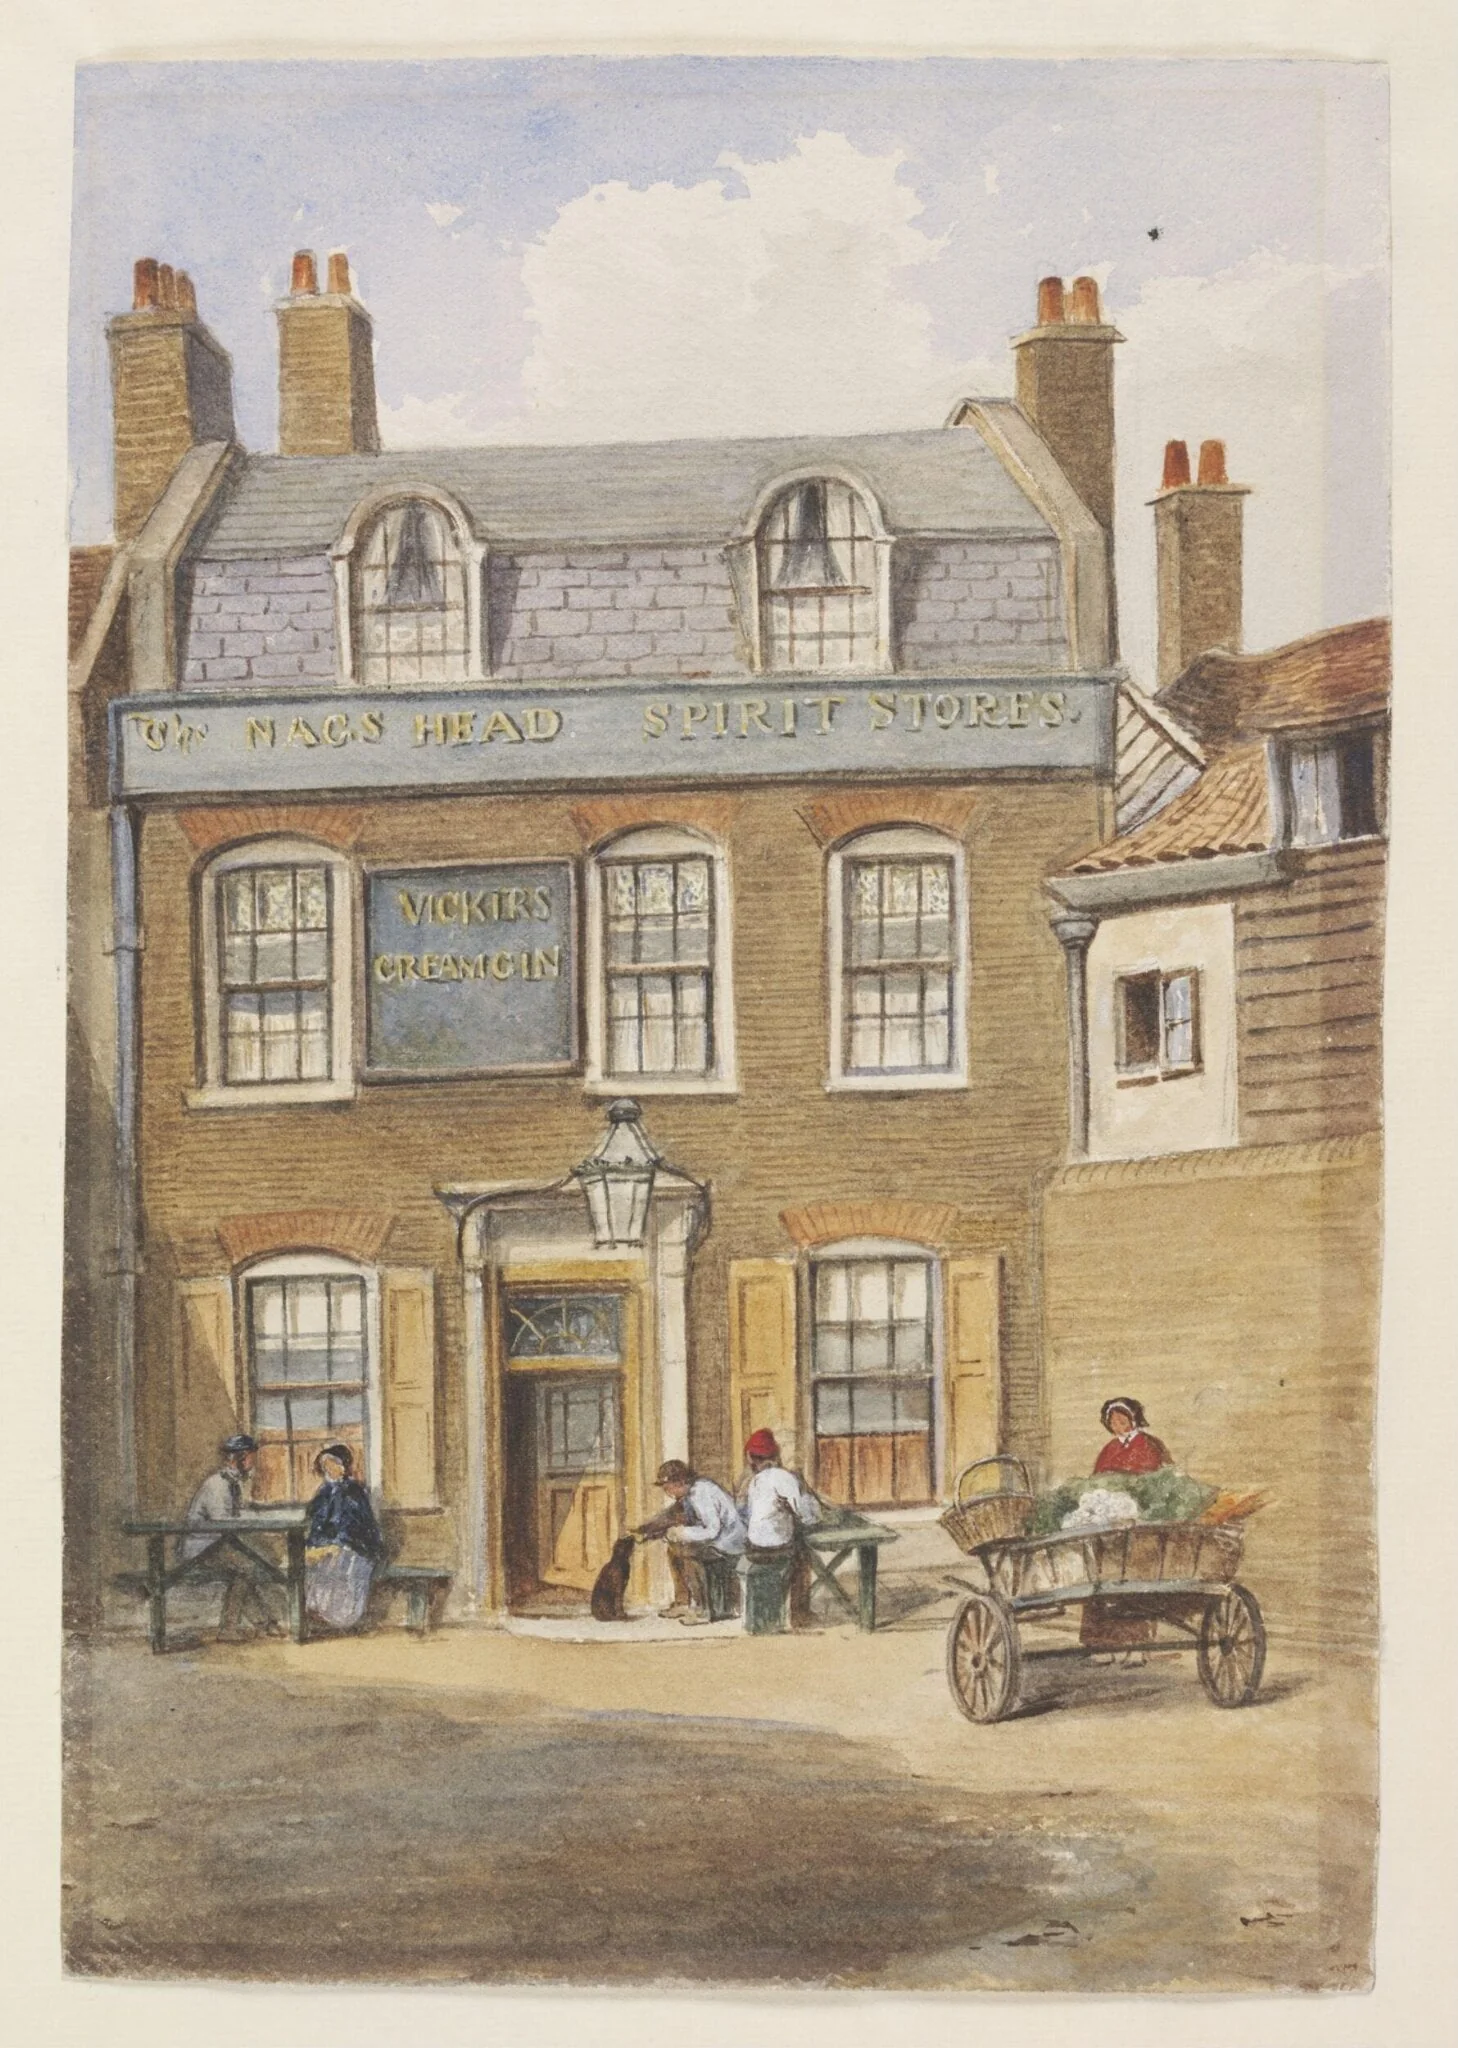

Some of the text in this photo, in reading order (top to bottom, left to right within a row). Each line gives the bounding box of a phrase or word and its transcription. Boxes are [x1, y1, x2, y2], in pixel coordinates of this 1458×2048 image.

[245, 710, 384, 750] NAGS
[413, 707, 563, 748] HEAD
[642, 696, 847, 742] SPIRIT
[373, 950, 487, 983] CREAM
